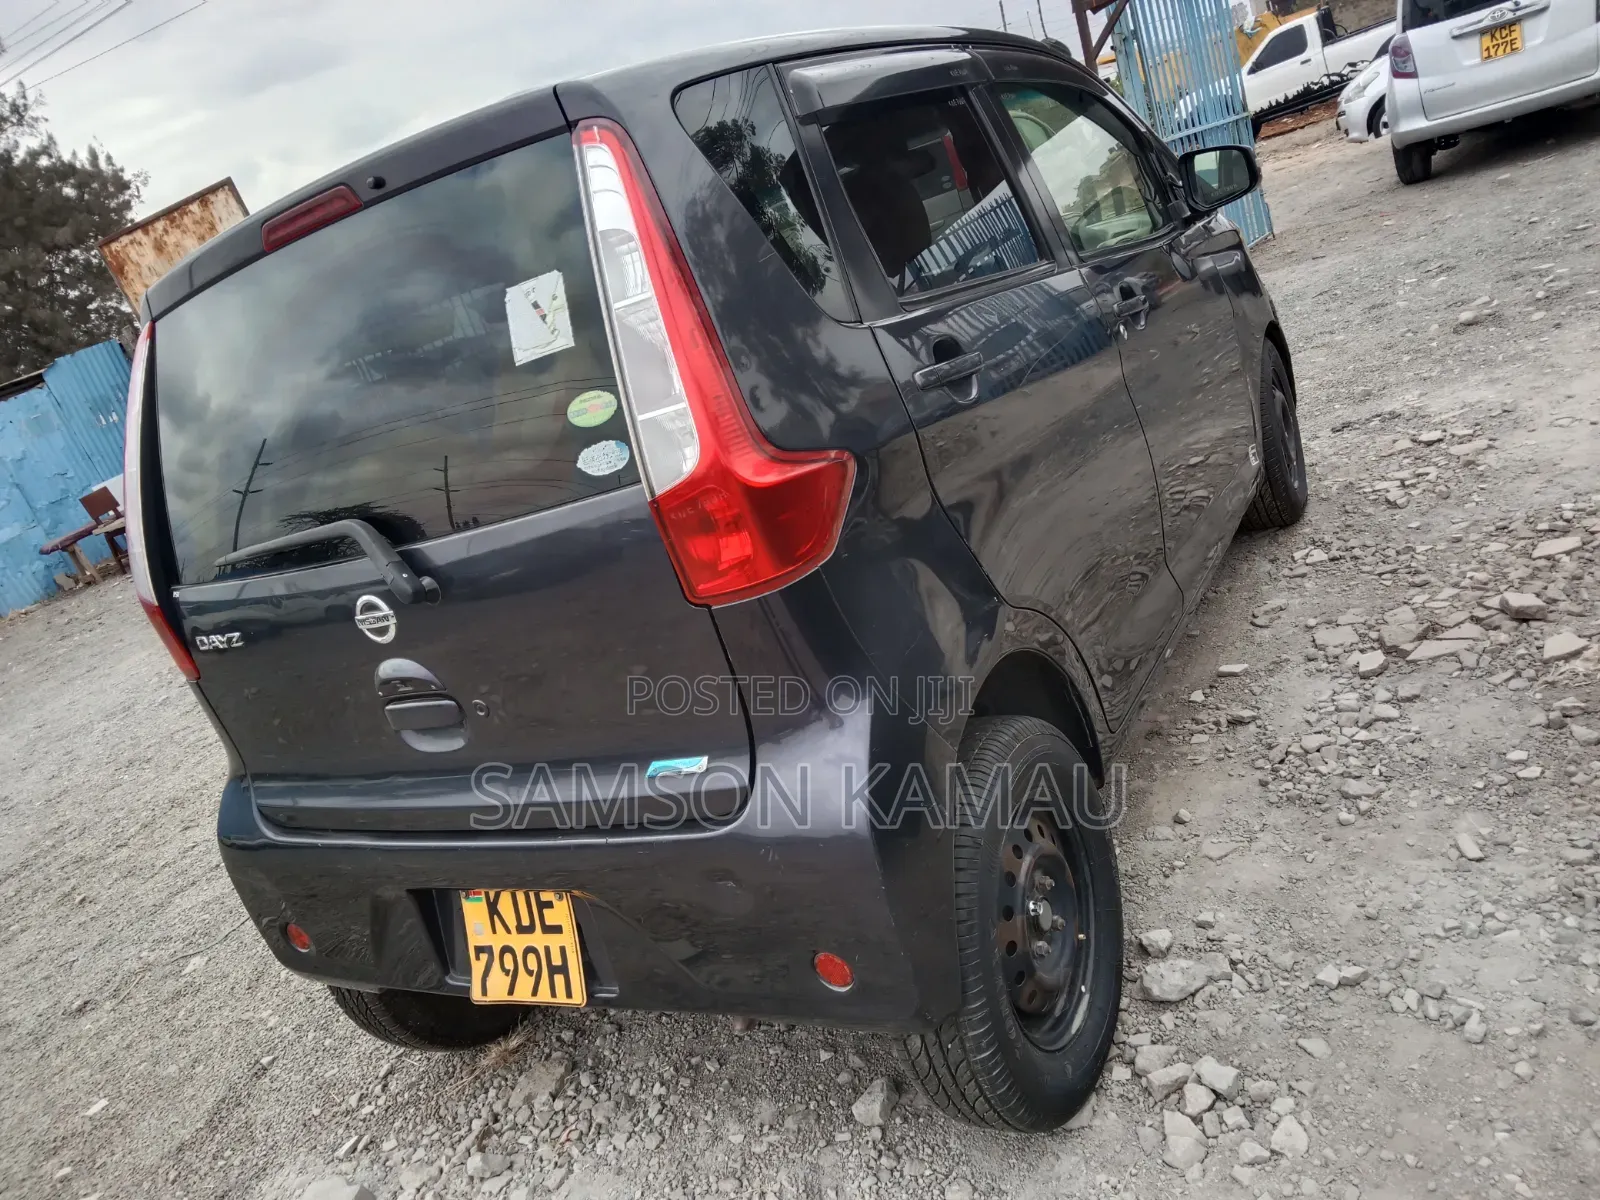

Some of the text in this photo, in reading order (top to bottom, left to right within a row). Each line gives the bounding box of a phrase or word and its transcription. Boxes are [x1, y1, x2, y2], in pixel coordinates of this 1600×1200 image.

[1490, 23, 1517, 43] KCF
[1484, 37, 1520, 60] 177E
[357, 614, 390, 627] NISSAN
[195, 631, 245, 650] DAYZ
[484, 890, 564, 935] KDE
[473, 944, 573, 1000] 799H
